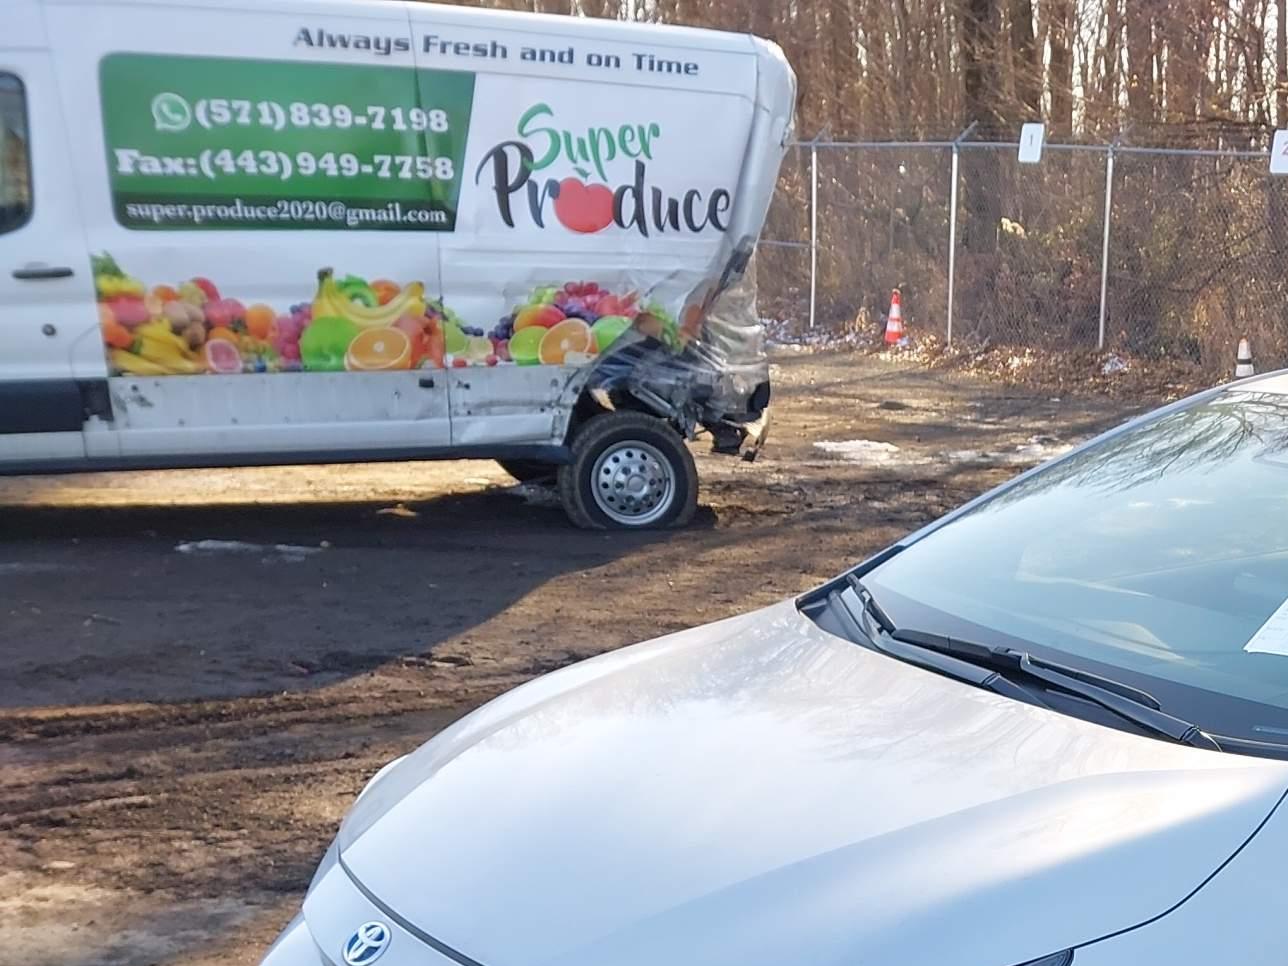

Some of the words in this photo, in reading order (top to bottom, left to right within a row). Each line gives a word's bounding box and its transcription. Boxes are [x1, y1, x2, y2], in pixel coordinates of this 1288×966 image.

[294, 27, 411, 57] Always
[422, 35, 508, 59] Fresh
[519, 46, 575, 65] and
[586, 55, 621, 69] on
[632, 53, 699, 77] Time
[517, 103, 660, 183] Super
[126, 199, 448, 225] super.produce2020@gmail.com
